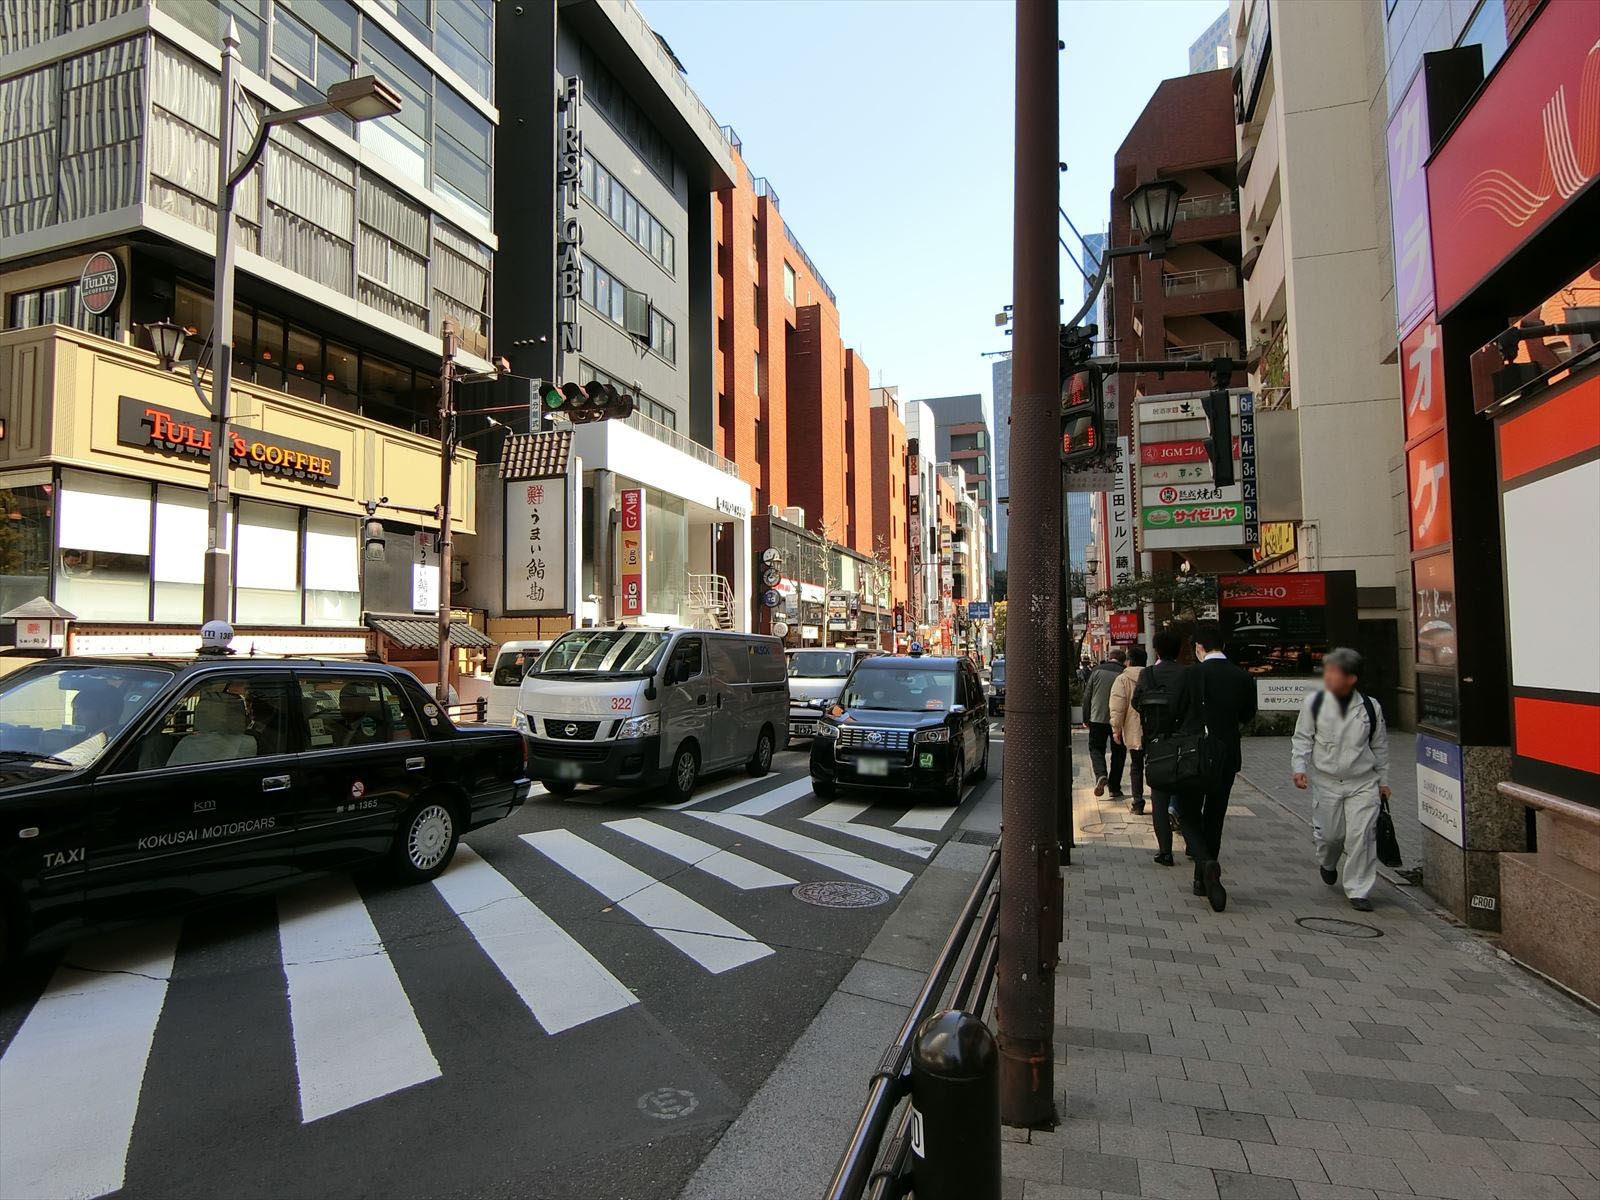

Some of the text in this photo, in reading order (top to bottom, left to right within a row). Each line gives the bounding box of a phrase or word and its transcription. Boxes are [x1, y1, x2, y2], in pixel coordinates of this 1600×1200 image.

[562, 74, 579, 208] FIRST
[561, 217, 579, 352] CABIN
[1240, 397, 1252, 411] 6F
[1241, 419, 1253, 432] 5F
[145, 408, 332, 477] TULL'S COFFEE
[1242, 440, 1254, 454] 4F
[1160, 448, 1183, 458] JGM
[1243, 463, 1254, 476] 3F
[527, 485, 545, 505] 鮮
[1244, 485, 1255, 498] 2F
[625, 492, 638, 528] 宝くじ
[1174, 507, 1236, 523] サイゼリヤ
[1245, 506, 1256, 519] B1
[1246, 528, 1257, 541] B2
[625, 539, 638, 548] 7
[526, 508, 546, 602] うまい鮨勘
[624, 583, 638, 609] BIG
[1433, 587, 1452, 618] Bar
[1234, 611, 1251, 625] J's
[1255, 611, 1277, 625] Bar
[611, 697, 632, 710] 322
[359, 799, 378, 810] 1365
[138, 816, 276, 850] KOKUSAI MOTORCARS
[44, 847, 86, 868] TAXI
